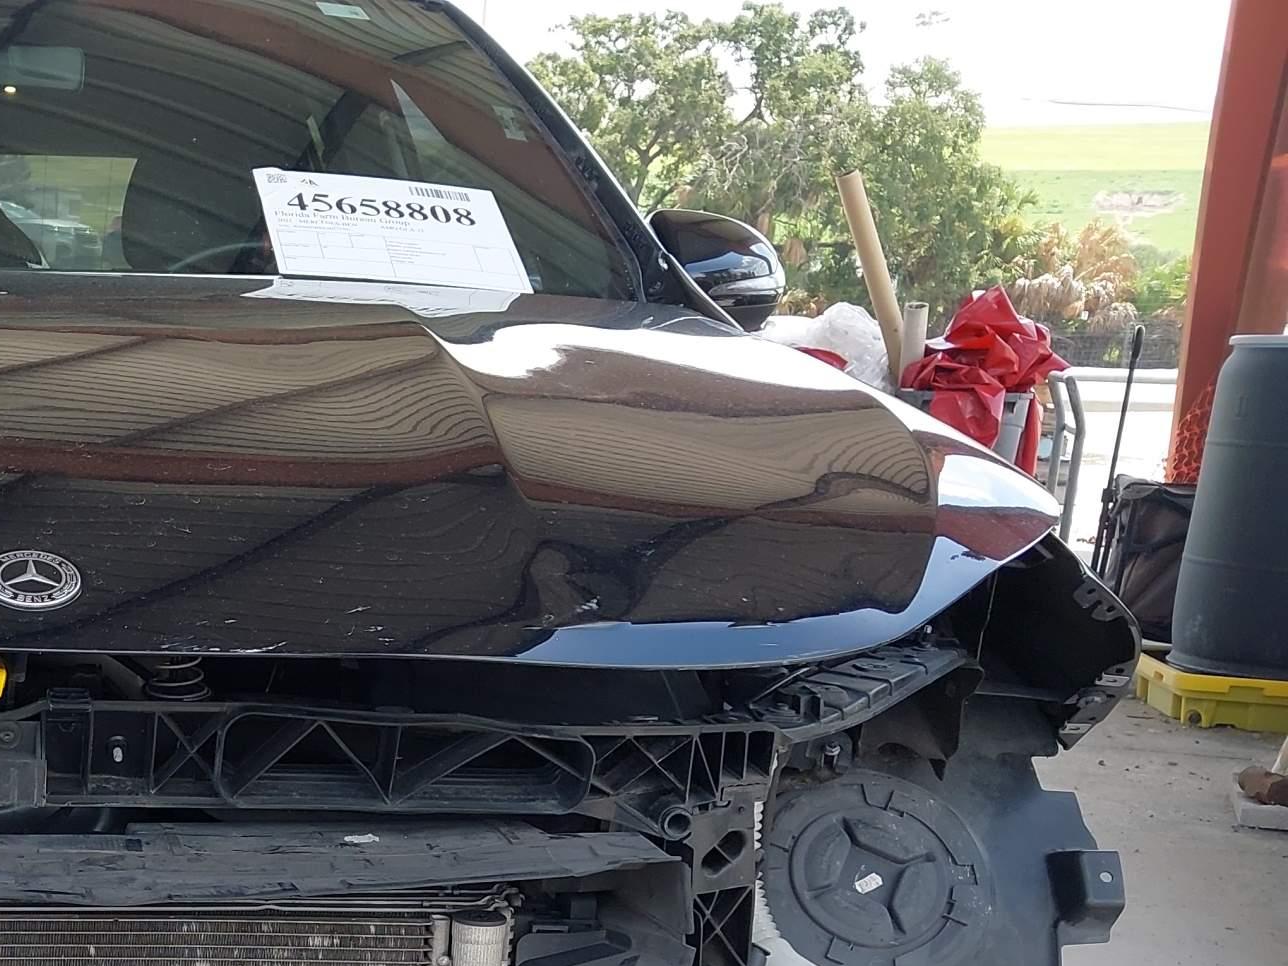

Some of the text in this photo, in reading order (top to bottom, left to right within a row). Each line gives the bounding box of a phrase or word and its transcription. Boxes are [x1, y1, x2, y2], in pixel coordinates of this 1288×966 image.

[287, 192, 476, 225] 45658808
[0, 552, 62, 564] MERCEDES
[16, 594, 51, 603] BENZ
